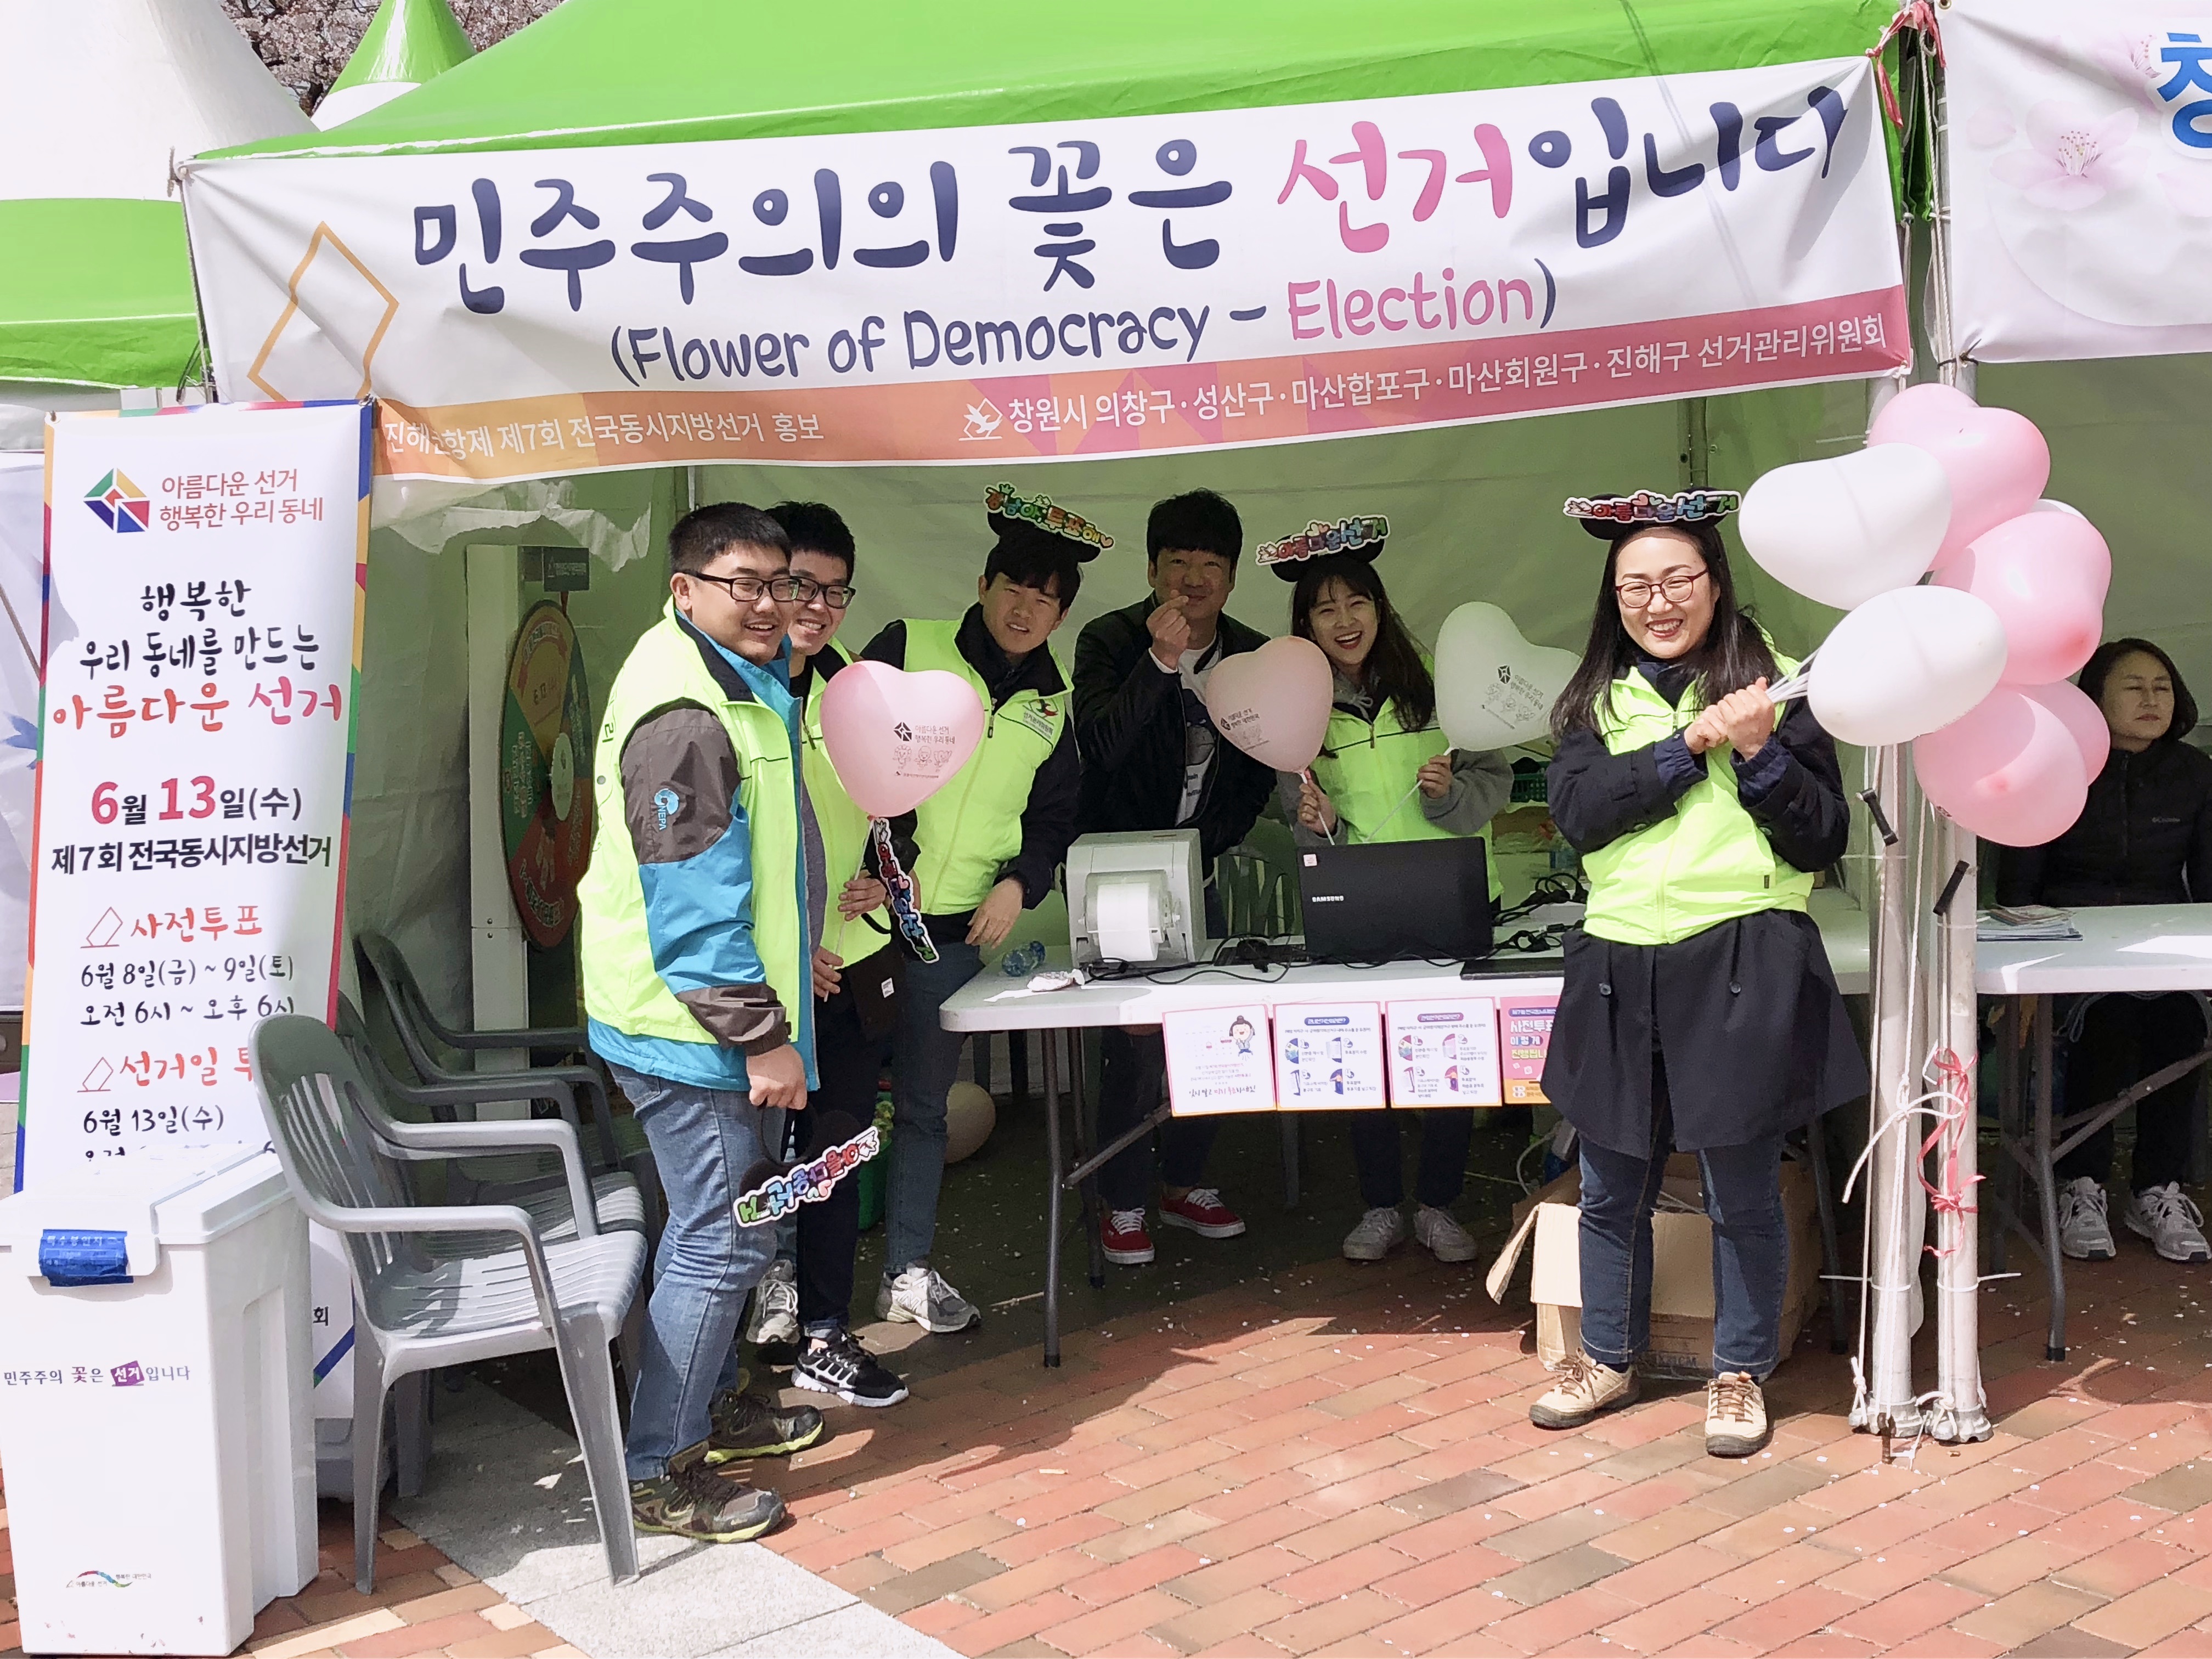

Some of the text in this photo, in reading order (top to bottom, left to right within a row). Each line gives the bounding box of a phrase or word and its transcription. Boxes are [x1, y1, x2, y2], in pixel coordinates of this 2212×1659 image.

[414, 86, 1849, 314] 민주주의의 꽃은 선거입니다
[611, 325, 810, 387] (Flower
[827, 316, 885, 374] of
[904, 304, 1210, 371] Democracy
[1288, 257, 1556, 340] Election)
[1008, 393, 1088, 433] 창원시
[1698, 313, 1887, 368] 선거관리위원회
[497, 419, 565, 454] 제7회
[567, 411, 765, 448] 전국동시지방선거
[774, 411, 825, 443] 홍보
[161, 469, 298, 500] 아름다운 선거
[160, 496, 324, 532] 행복한 우리 동네
[141, 579, 252, 622] 행복한
[80, 624, 320, 680] 우리 동네를 만드는
[53, 675, 343, 738] 아름다운 선거
[91, 775, 302, 825] 6월 13일(수)
[658, 805, 667, 831] NEPA
[52, 832, 332, 875] 제7회 전국동시지방선거
[130, 905, 263, 943] 사전투표
[81, 963, 115, 990] 6월
[122, 958, 198, 988] 8일(금)
[223, 955, 295, 983] 9일(토)
[80, 1003, 125, 1028] 오전
[134, 1000, 171, 1025] 6시
[203, 997, 248, 1022] 오후
[257, 994, 295, 1017] 6시
[119, 1047, 218, 1086] 선거일
[83, 1105, 225, 1137] 6월 13일(수)
[4, 1369, 63, 1385] 민주주의
[71, 1367, 104, 1383] 꽃은
